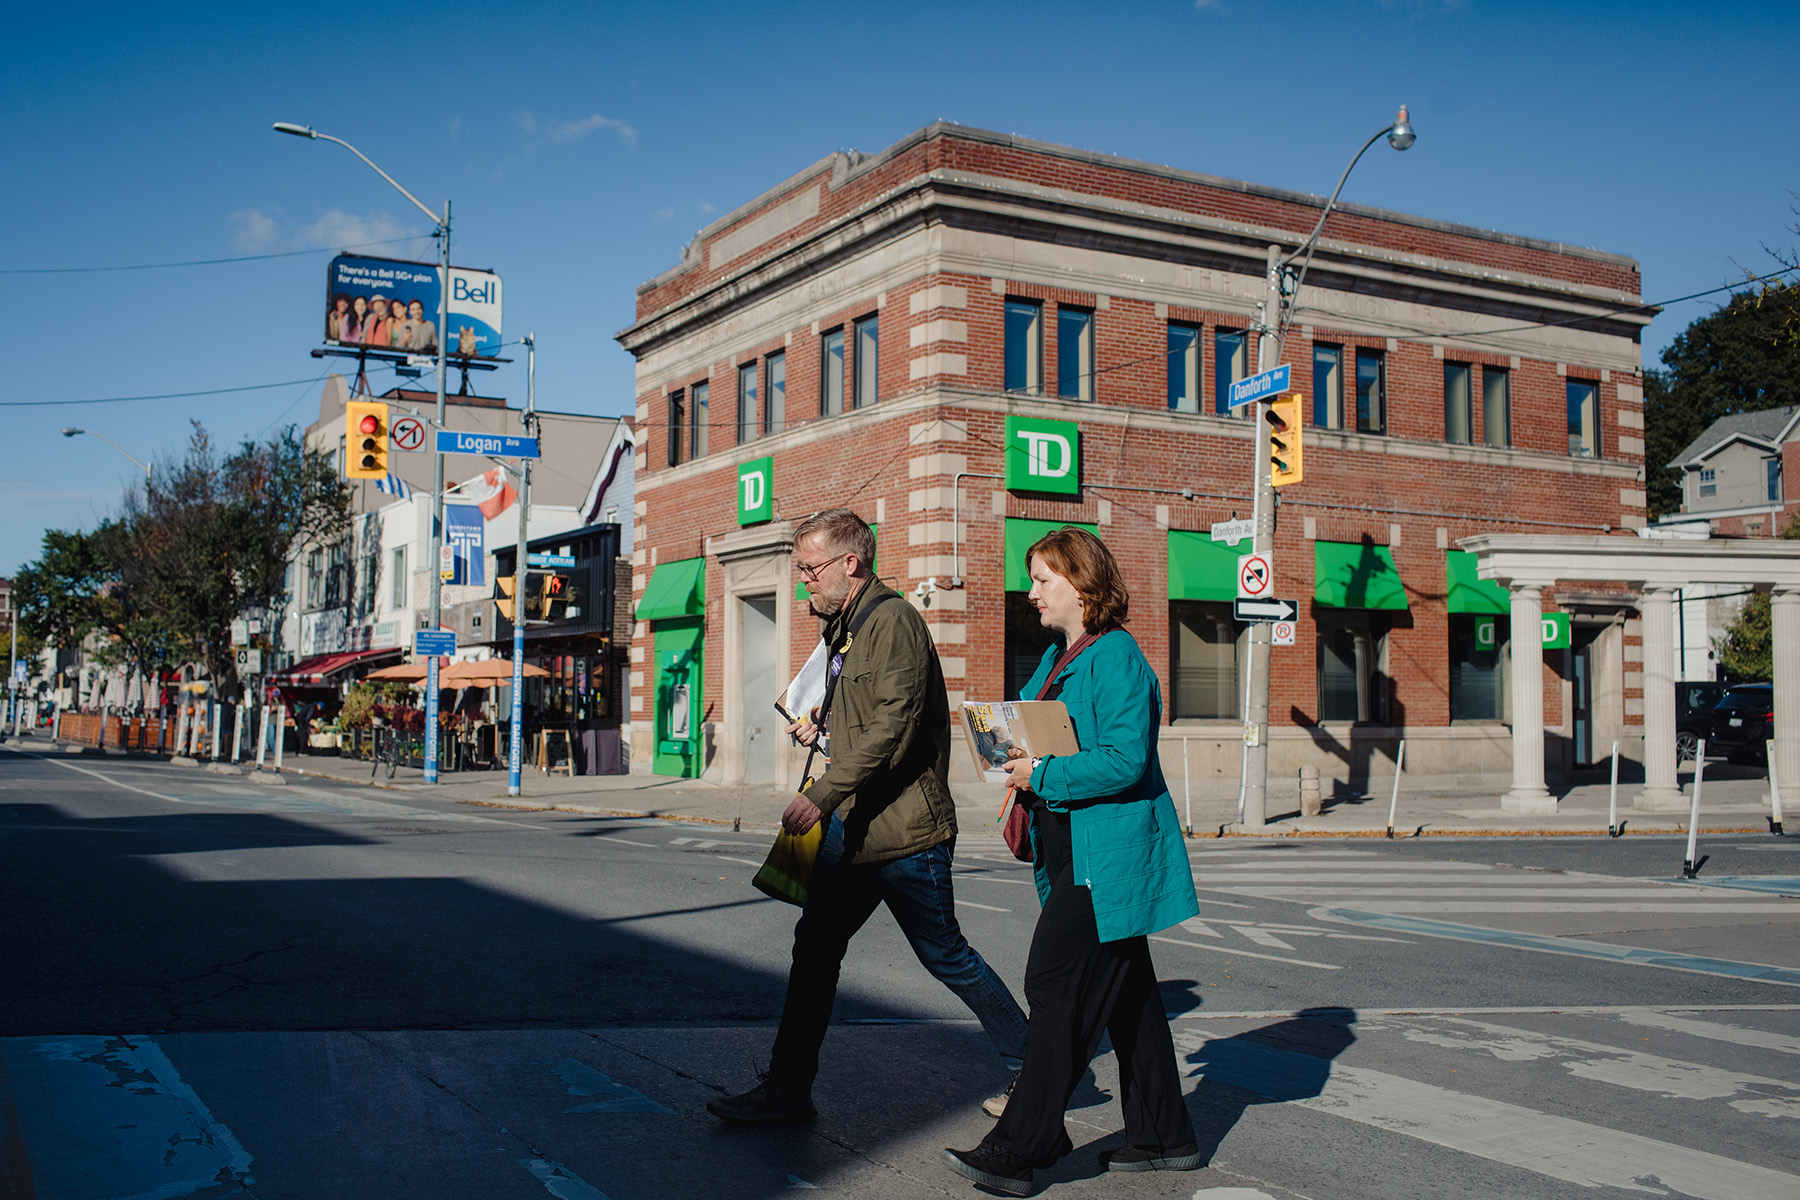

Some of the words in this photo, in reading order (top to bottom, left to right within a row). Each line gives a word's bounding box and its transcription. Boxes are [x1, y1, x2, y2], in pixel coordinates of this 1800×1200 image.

[338, 264, 369, 277] There's
[378, 269, 394, 278] Bell
[395, 270, 412, 281] 5G+
[413, 273, 432, 283] plan
[338, 274, 351, 283] for
[352, 276, 395, 289] everyone.
[453, 277, 495, 304] Bell
[1234, 373, 1271, 401] Danforth
[1273, 370, 1283, 380] Ave
[457, 434, 501, 454] Logan
[506, 437, 520, 448] Ave
[1017, 430, 1072, 478] TD
[740, 470, 765, 511] TD
[1213, 524, 1242, 538] Danforth
[513, 649, 523, 705] GREEKTOWN
[977, 706, 991, 733] Sara
[429, 717, 438, 762] DANFORTH
[511, 724, 521, 773] DANFORTH
